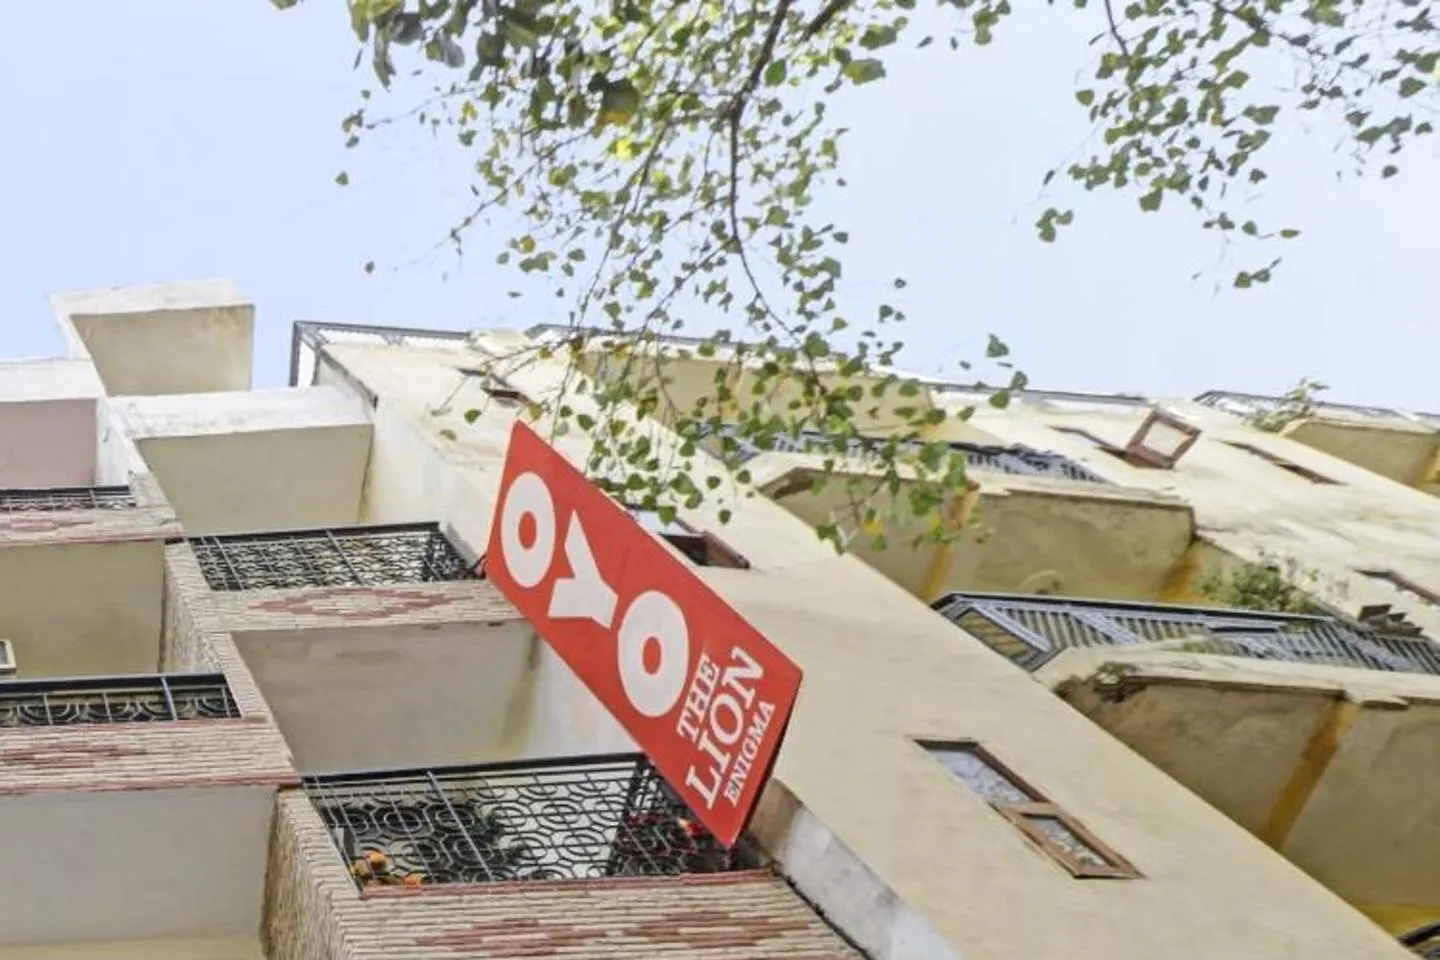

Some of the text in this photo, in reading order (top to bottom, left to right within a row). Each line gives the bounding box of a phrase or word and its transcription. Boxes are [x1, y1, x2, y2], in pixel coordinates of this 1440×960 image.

[501, 471, 690, 717] OYO
[676, 652, 721, 743] THE
[685, 645, 765, 810] LION
[723, 700, 776, 807] ENIGMA
